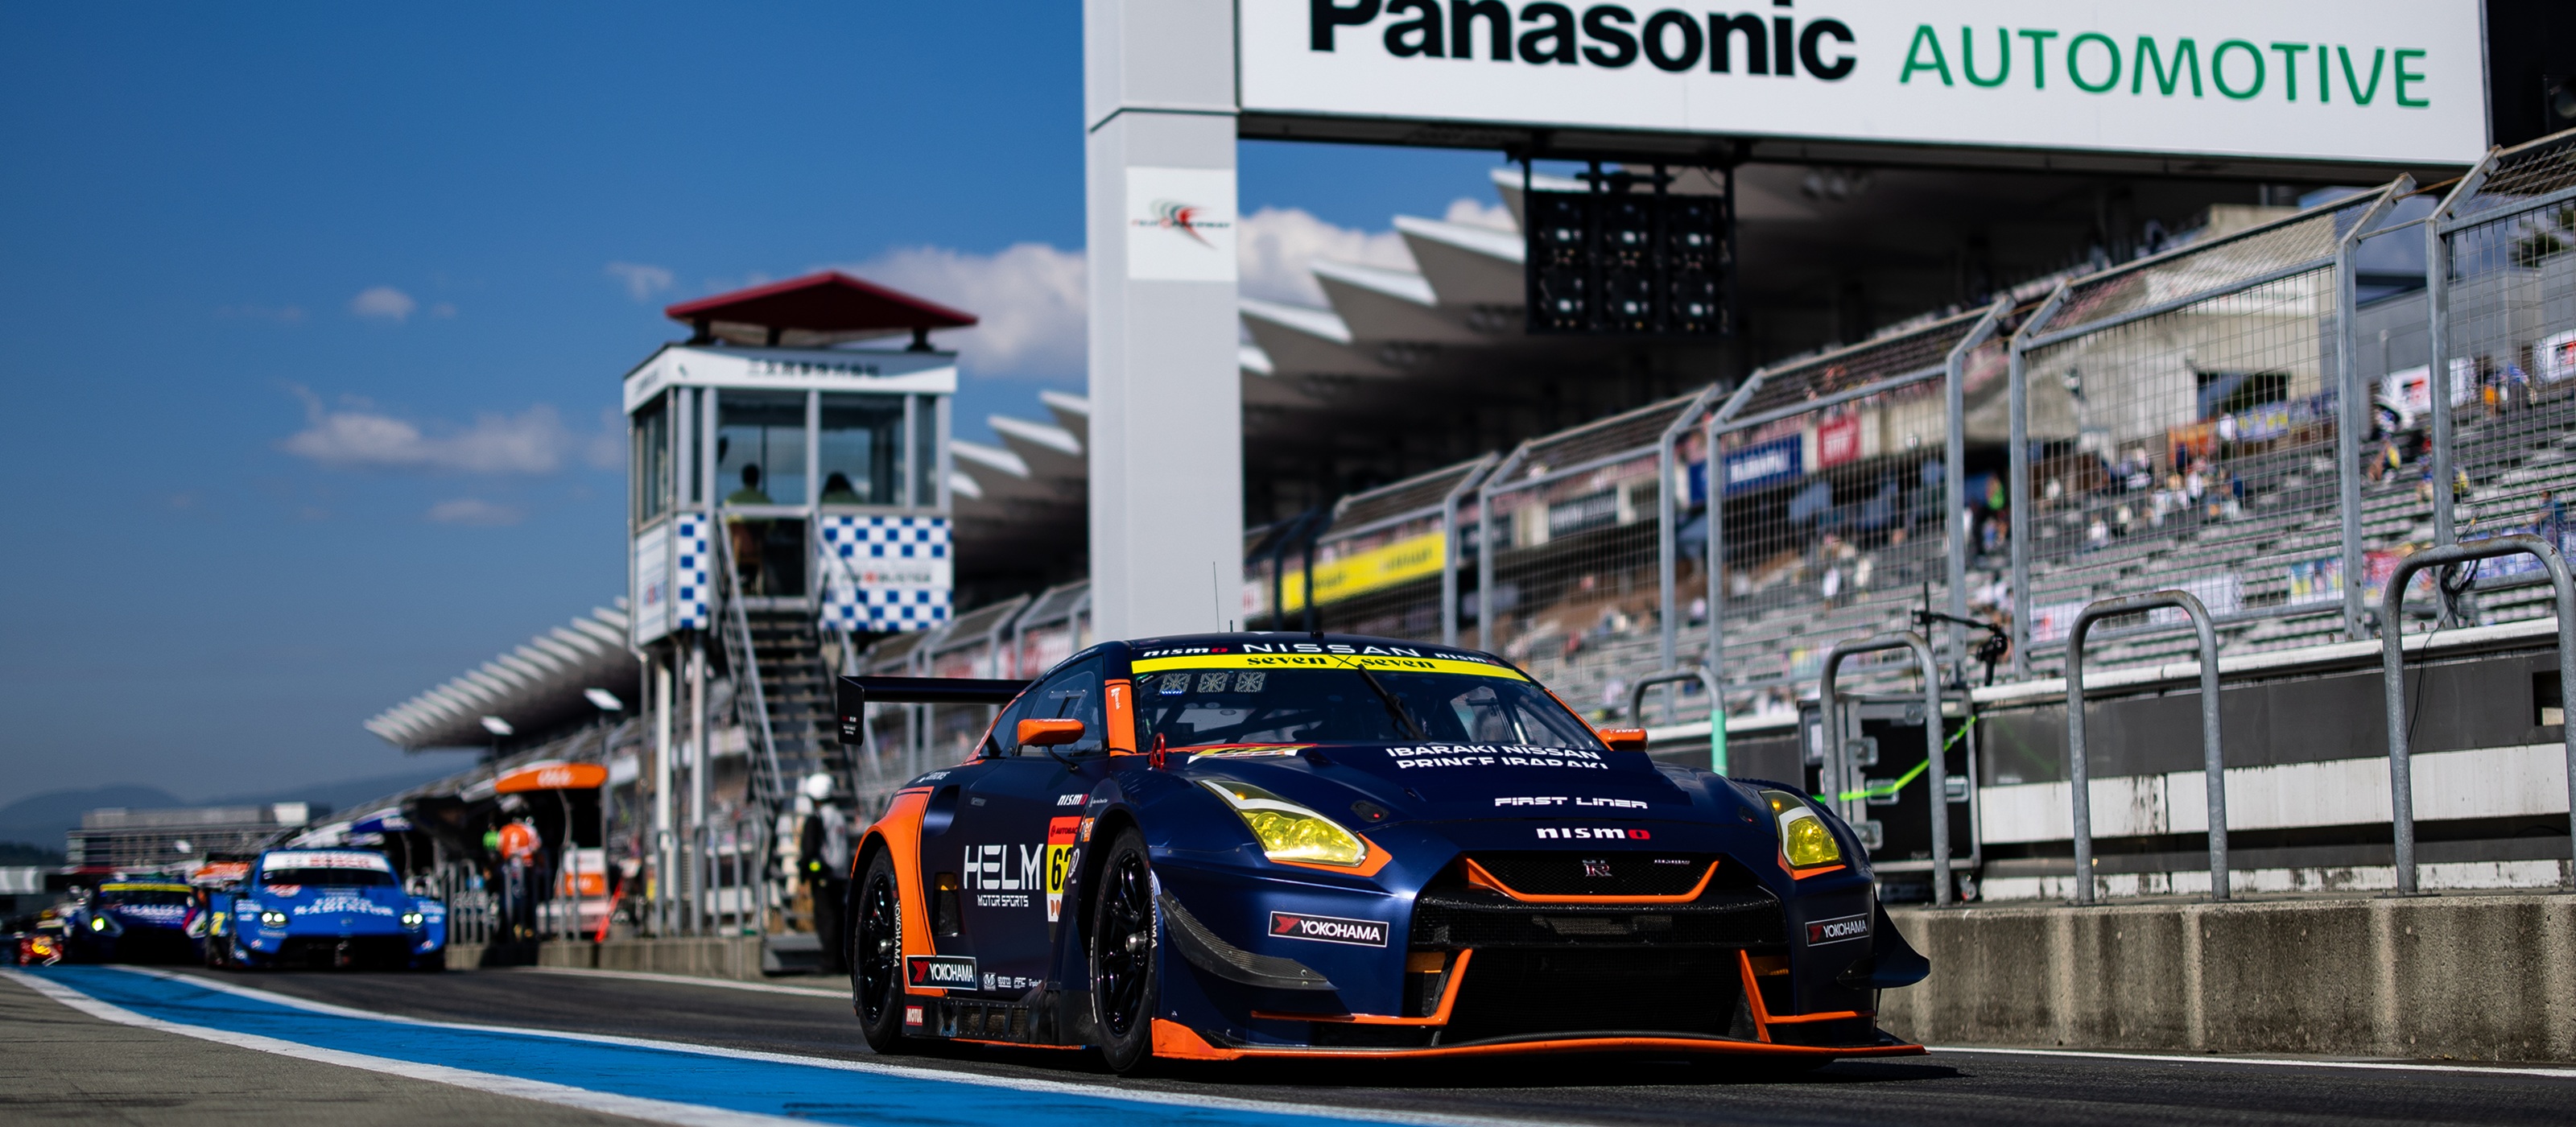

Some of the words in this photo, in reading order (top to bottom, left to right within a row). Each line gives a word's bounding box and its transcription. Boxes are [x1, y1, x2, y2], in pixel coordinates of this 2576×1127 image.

[1310, 0, 1857, 81] Panasonic
[1898, 24, 2430, 108] AUTOMOTIVE
[1143, 646, 1228, 657] nismo
[1243, 643, 1422, 658] NISSAN
[1247, 656, 1328, 666] seven
[1360, 658, 1436, 669] seven
[1385, 745, 1498, 758] IBARAKI
[1498, 745, 1602, 760] NISSAN
[1495, 797, 1568, 807] FIRST
[1056, 827, 1079, 835] AUTOBAC
[1536, 828, 1650, 840] nismo
[964, 844, 1044, 890] HELM
[977, 894, 1001, 906] MOTOR
[1001, 895, 1029, 907] SPORTS
[894, 900, 902, 967] YOKOHAMA
[1301, 920, 1381, 941] YOKOHAMA
[1823, 919, 1868, 939] YOKOHAMA
[930, 964, 974, 983] YOKOHAMA
[906, 1008, 923, 1022] MOTUL
